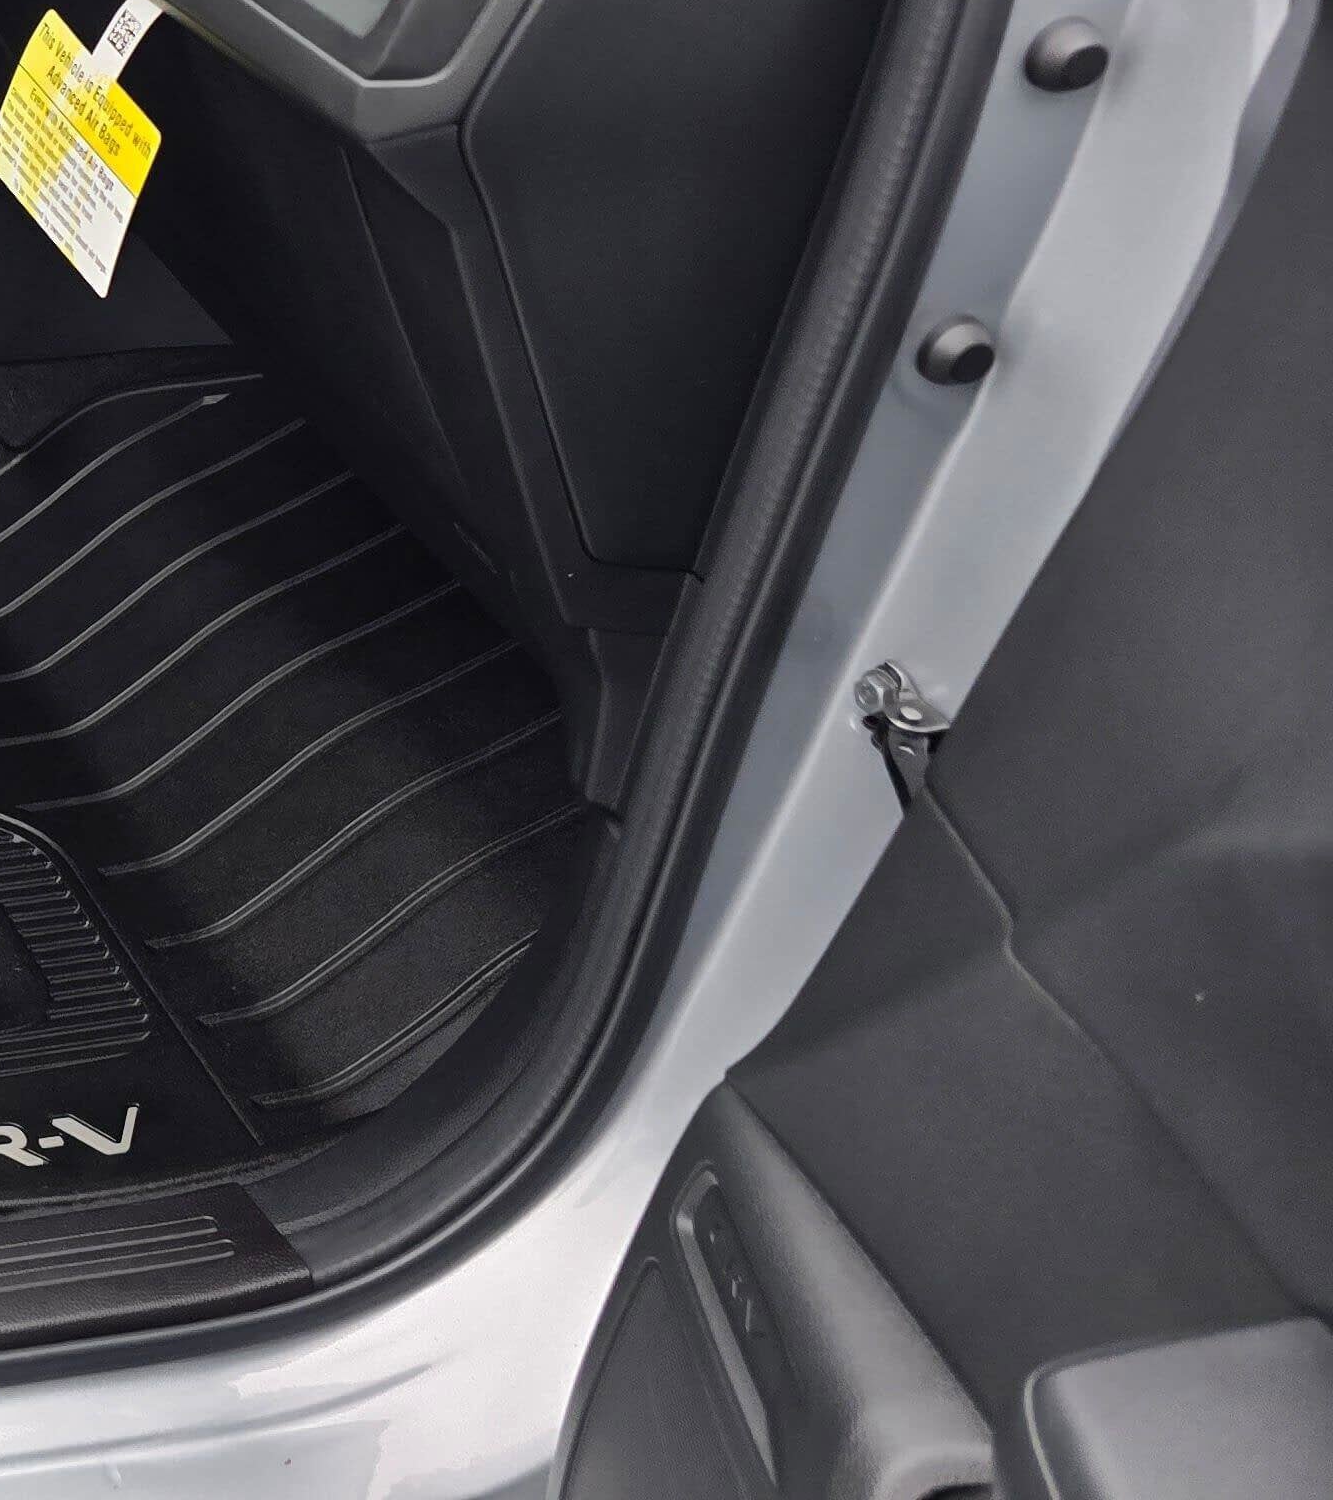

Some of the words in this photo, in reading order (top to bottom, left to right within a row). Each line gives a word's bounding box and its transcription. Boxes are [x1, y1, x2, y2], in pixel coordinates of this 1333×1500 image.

[39, 21, 56, 49] This
[55, 39, 85, 82] Vehicle
[92, 85, 132, 139] Equipped
[131, 128, 151, 159] with
[46, 61, 86, 115] Advanced
[85, 106, 99, 130] Air
[97, 123, 121, 158] Bags
